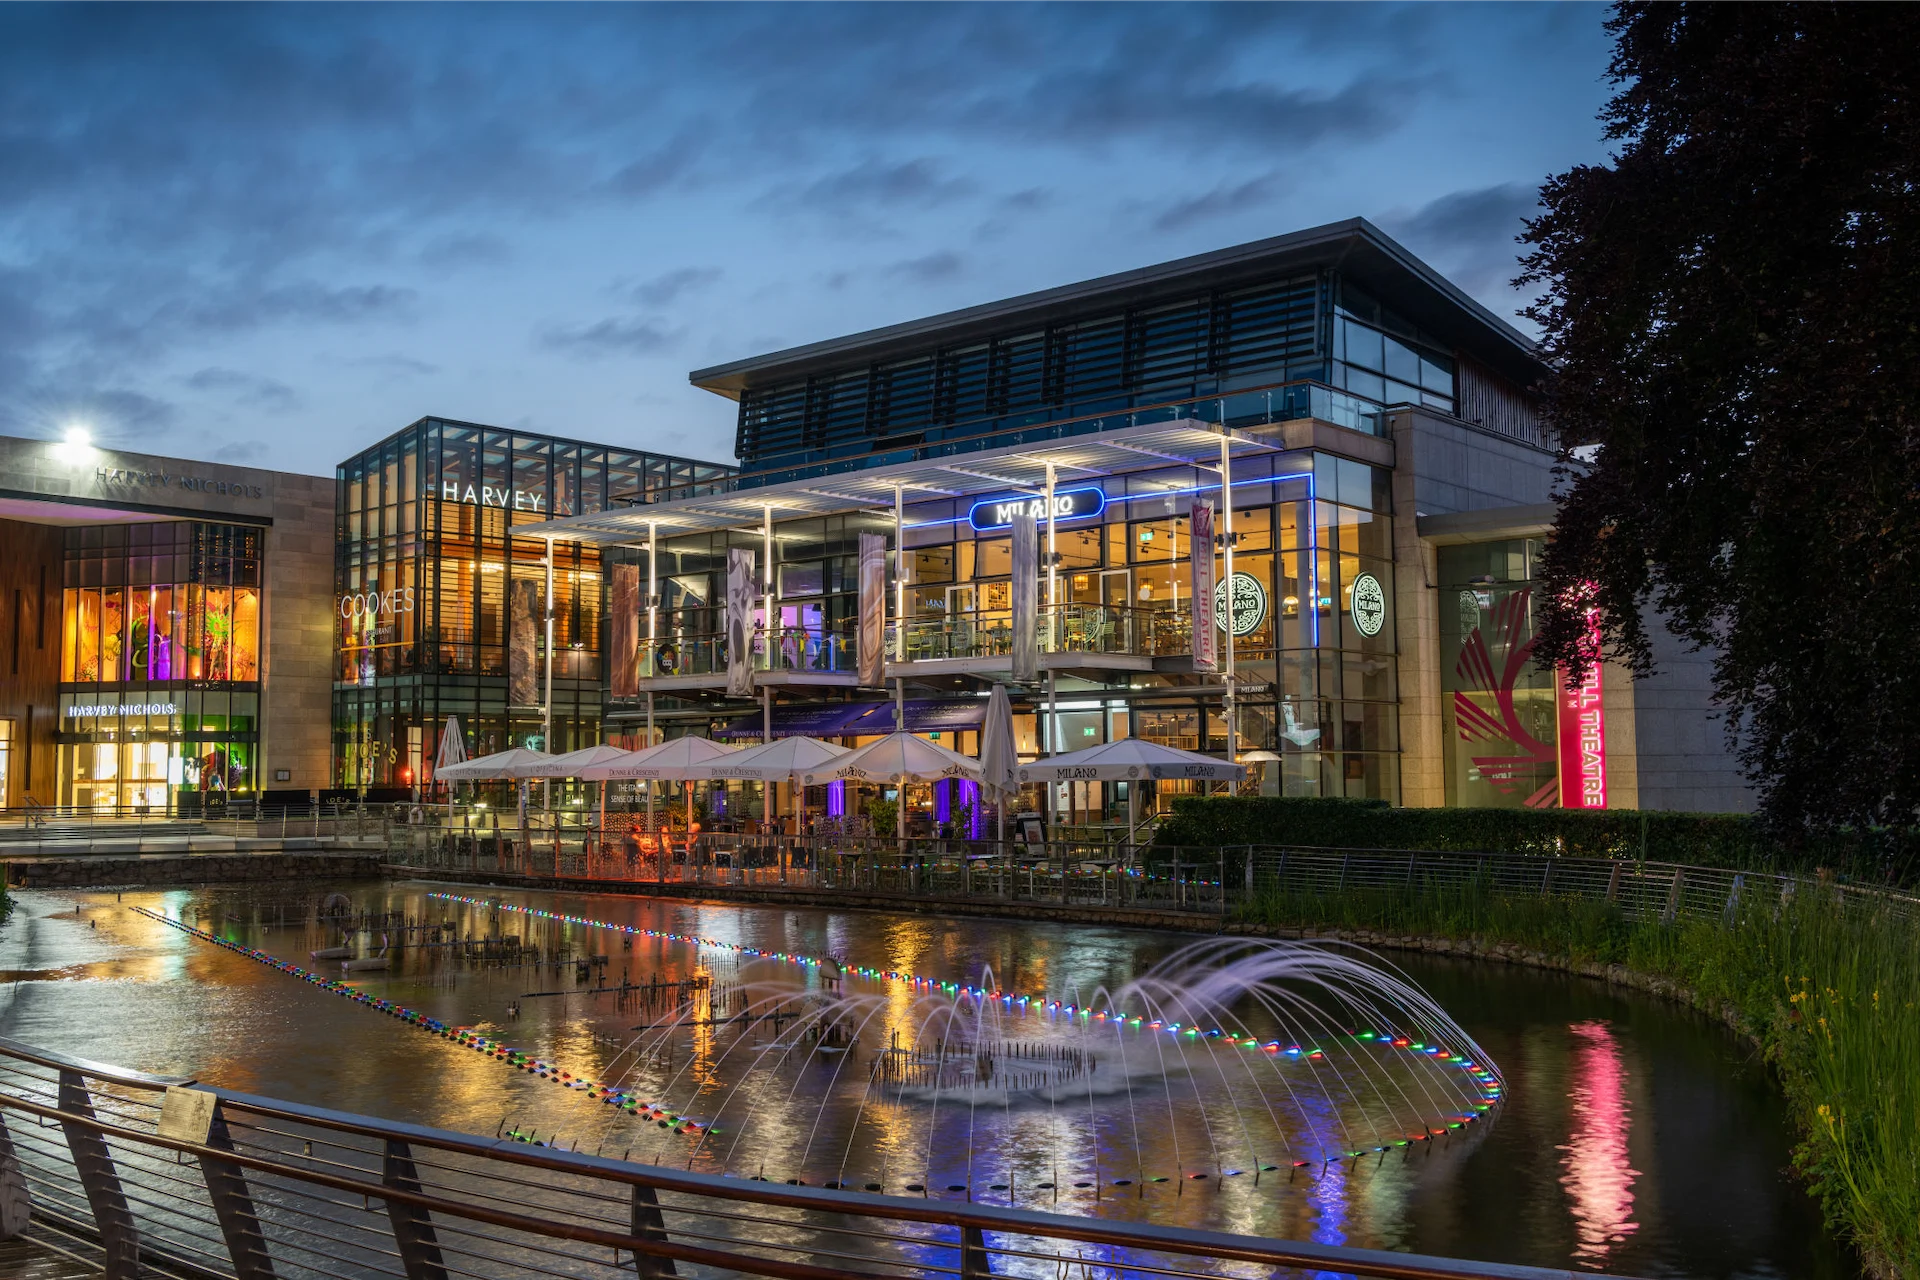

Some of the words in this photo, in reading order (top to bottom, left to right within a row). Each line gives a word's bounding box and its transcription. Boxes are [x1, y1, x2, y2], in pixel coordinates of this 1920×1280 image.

[96, 467, 172, 488] HARVEY
[180, 476, 262, 499] NICHOLS
[442, 480, 542, 512] HARVEY
[1200, 541, 1208, 577] MILL
[341, 587, 414, 619] COOKES
[1218, 599, 1256, 611] MANO
[1358, 600, 1381, 611] MILANO
[1200, 588, 1210, 657] THEATRE
[1240, 685, 1265, 693] MILANO
[69, 705, 117, 717] HARVEY
[119, 703, 176, 716] NICHOLS
[1580, 710, 1603, 807] THEATRE
[1057, 767, 1097, 779] MILANO
[1184, 766, 1215, 777] MILANO
[618, 784, 628, 792] THE
[610, 795, 626, 803] SENSE
